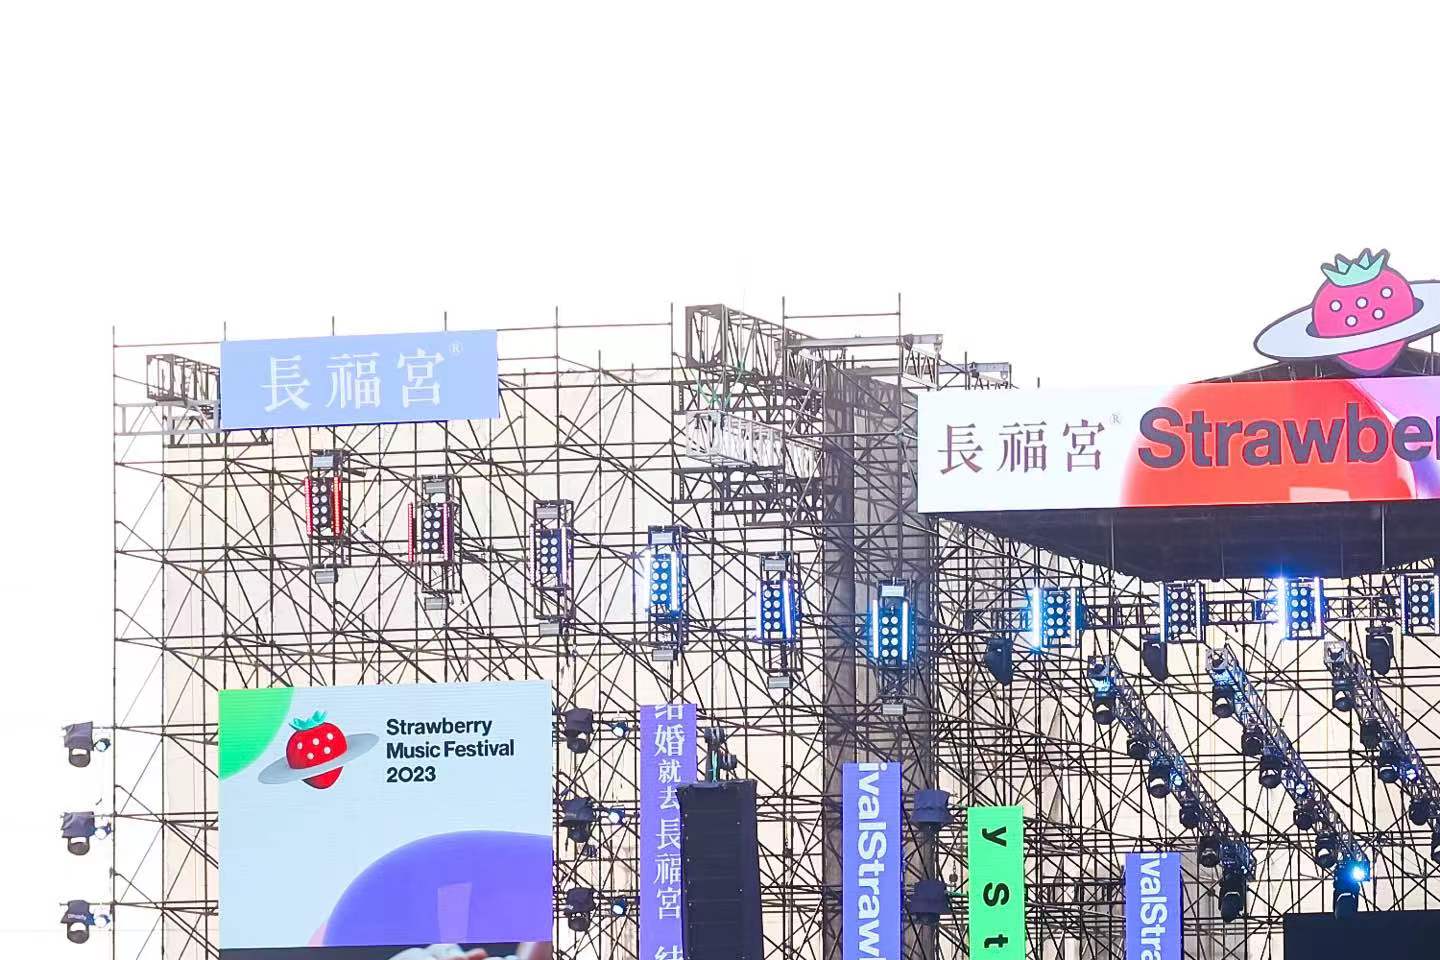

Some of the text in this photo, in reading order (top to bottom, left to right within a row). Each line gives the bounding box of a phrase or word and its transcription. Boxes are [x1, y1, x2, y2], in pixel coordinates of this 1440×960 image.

[260, 347, 445, 412] 長福宮
[937, 419, 1105, 475] 長福宮
[386, 717, 492, 736] Strawberry
[387, 739, 514, 759] Music Festival
[387, 766, 436, 782] 2023
